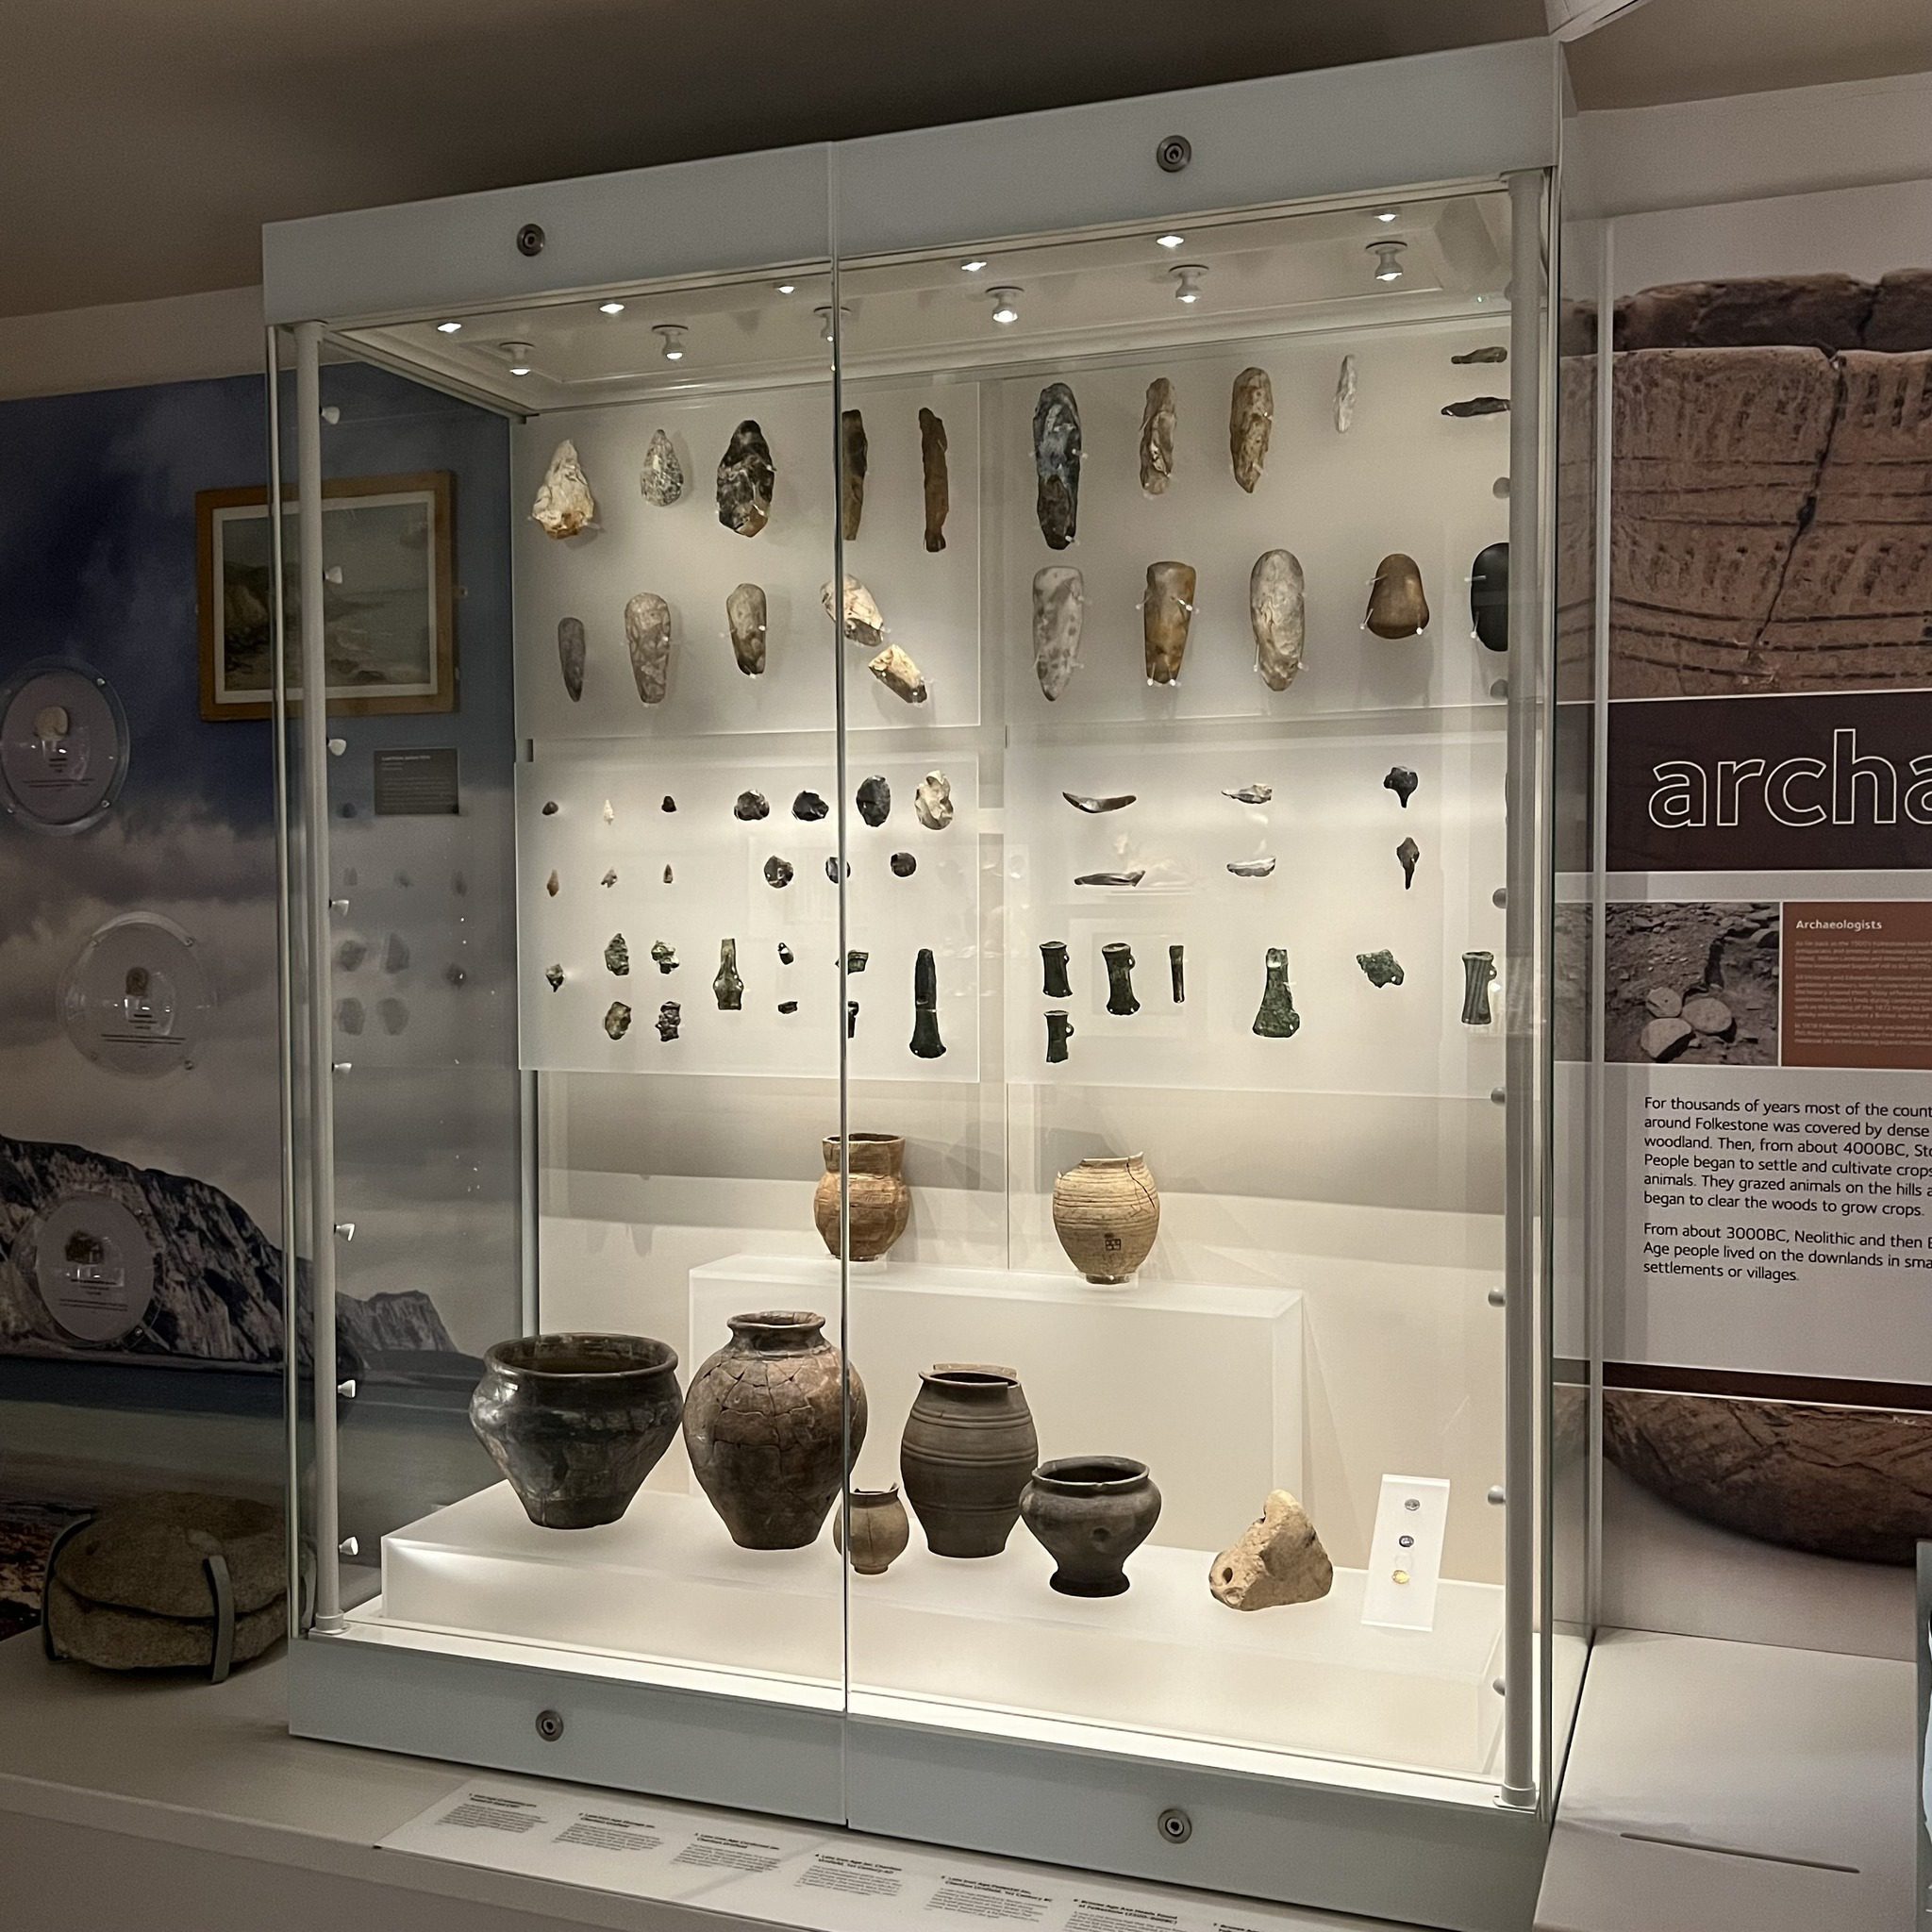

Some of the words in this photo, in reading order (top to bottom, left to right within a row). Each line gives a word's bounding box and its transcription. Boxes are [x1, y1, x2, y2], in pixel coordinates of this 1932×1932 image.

[1795, 919, 1883, 932] Archaeologists
[1645, 1097, 1667, 1109] For
[1671, 1097, 1740, 1111] thousands
[1745, 1099, 1760, 1111] of
[1762, 1104, 1800, 1115] years
[1806, 1104, 1840, 1115] most
[1845, 1102, 1860, 1115] of
[1865, 1103, 1889, 1116] the
[1893, 1107, 1932, 1117] count
[1645, 1117, 1690, 1128] around
[1696, 1117, 1768, 1131] Folkestone
[1774, 1123, 1800, 1132] was
[1805, 1122, 1860, 1135] covered
[1866, 1123, 1882, 1139] by
[1887, 1123, 1929, 1137] dense
[1644, 1136, 1712, 1149] woodland.
[1717, 1137, 1755, 1152] Then,
[1760, 1138, 1792, 1151] from
[1798, 1140, 1838, 1154] about
[1843, 1142, 1908, 1158] 4000BC,
[1645, 1154, 1689, 1170] People
[1694, 1155, 1735, 1172] began
[1740, 1158, 1754, 1170] to
[1758, 1158, 1797, 1172] settle
[1802, 1160, 1826, 1173] and
[1832, 1160, 1891, 1175] cultivate
[1644, 1174, 1696, 1187] animals.
[1702, 1174, 1734, 1191] They
[1739, 1177, 1785, 1192] grazed
[1790, 1179, 1840, 1192] animals
[1846, 1184, 1863, 1193] on
[1868, 1181, 1891, 1194] the
[1897, 1182, 1922, 1196] hills
[1644, 1191, 1685, 1208] began
[1690, 1194, 1703, 1206] to
[1707, 1194, 1740, 1208] clear
[1745, 1196, 1767, 1208] the
[1772, 1198, 1817, 1211] woods
[1823, 1200, 1837, 1212] to
[1841, 1204, 1877, 1216] grow
[1882, 1206, 1924, 1218] crops.
[1644, 1223, 1677, 1236] From
[1682, 1224, 1721, 1238] about
[1726, 1226, 1789, 1243] 3000BC,
[1795, 1230, 1855, 1245] Neolithic
[1859, 1234, 1885, 1246] and
[1890, 1234, 1923, 1248] then
[1643, 1241, 1670, 1257] Age
[1674, 1244, 1719, 1259] people
[1724, 1245, 1755, 1259] lived
[1759, 1251, 1776, 1260] on
[1781, 1248, 1804, 1262] the
[1808, 1250, 1883, 1266] downlands
[1889, 1255, 1900, 1266] in
[1905, 1258, 1932, 1269] sma
[1643, 1260, 1724, 1276] settlements
[1728, 1268, 1742, 1277] or
[1747, 1266, 1798, 1283] villages.
